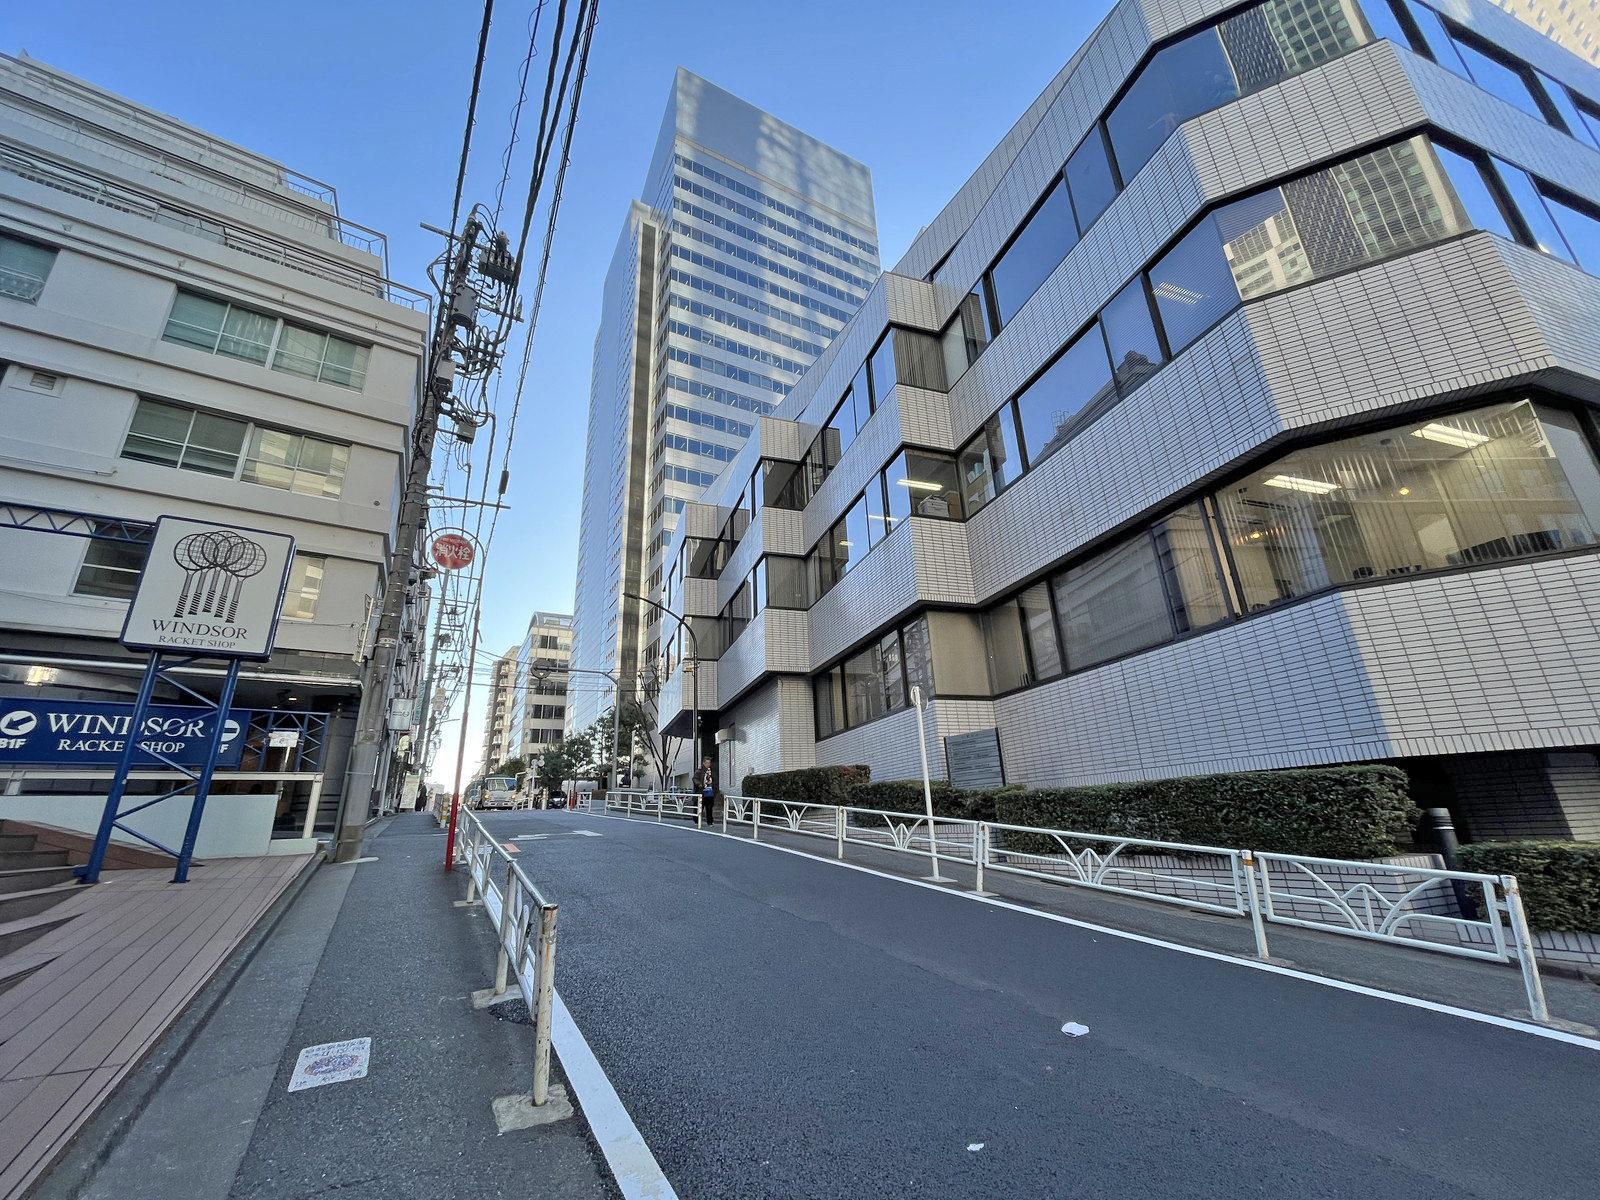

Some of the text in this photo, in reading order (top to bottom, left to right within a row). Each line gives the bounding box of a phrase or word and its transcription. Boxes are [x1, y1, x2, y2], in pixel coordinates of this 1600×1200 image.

[435, 542, 471, 561] 消火栓
[152, 619, 247, 640] WINDSOR
[159, 635, 236, 649] RACKET SHOP
[57, 739, 186, 753] RACKE SHOP
